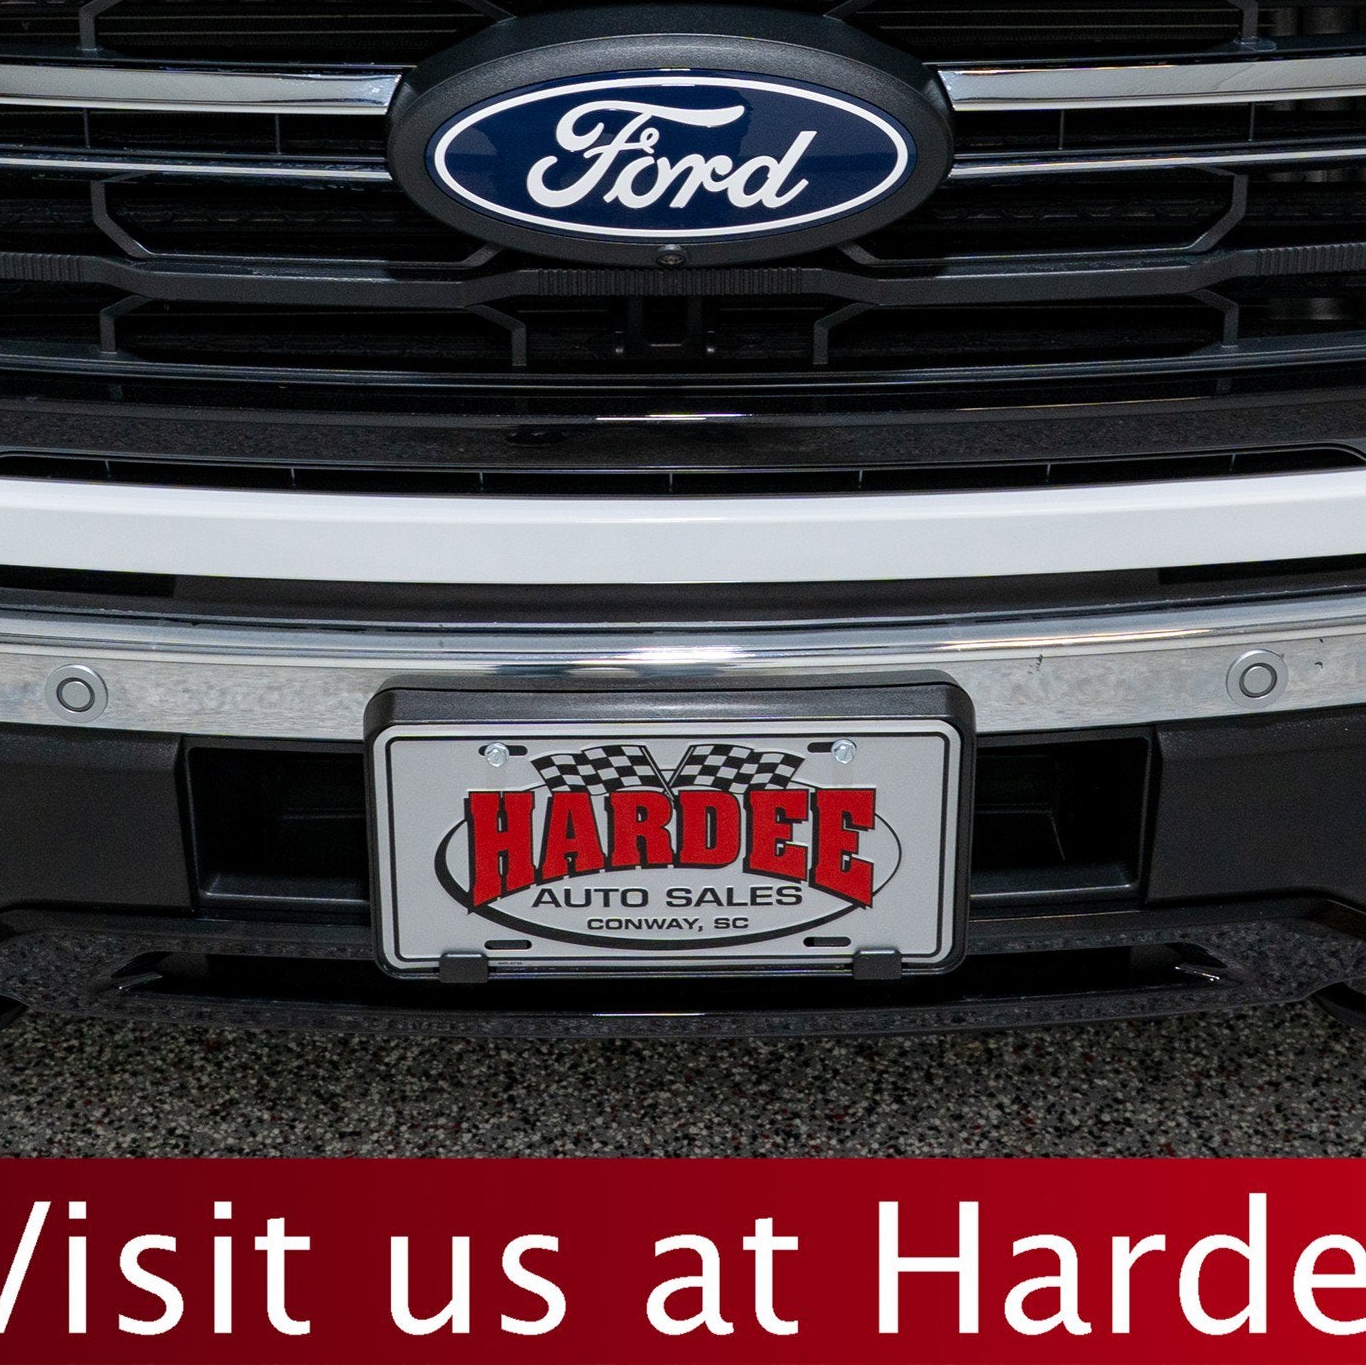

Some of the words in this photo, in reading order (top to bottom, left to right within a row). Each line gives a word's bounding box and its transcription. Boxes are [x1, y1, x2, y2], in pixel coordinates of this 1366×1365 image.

[526, 100, 818, 209] Ford
[463, 787, 878, 914] HARDEE
[531, 887, 649, 908] AUTO
[665, 885, 803, 908] SALES
[586, 916, 703, 933] CONWAY,
[714, 916, 750, 931] SC
